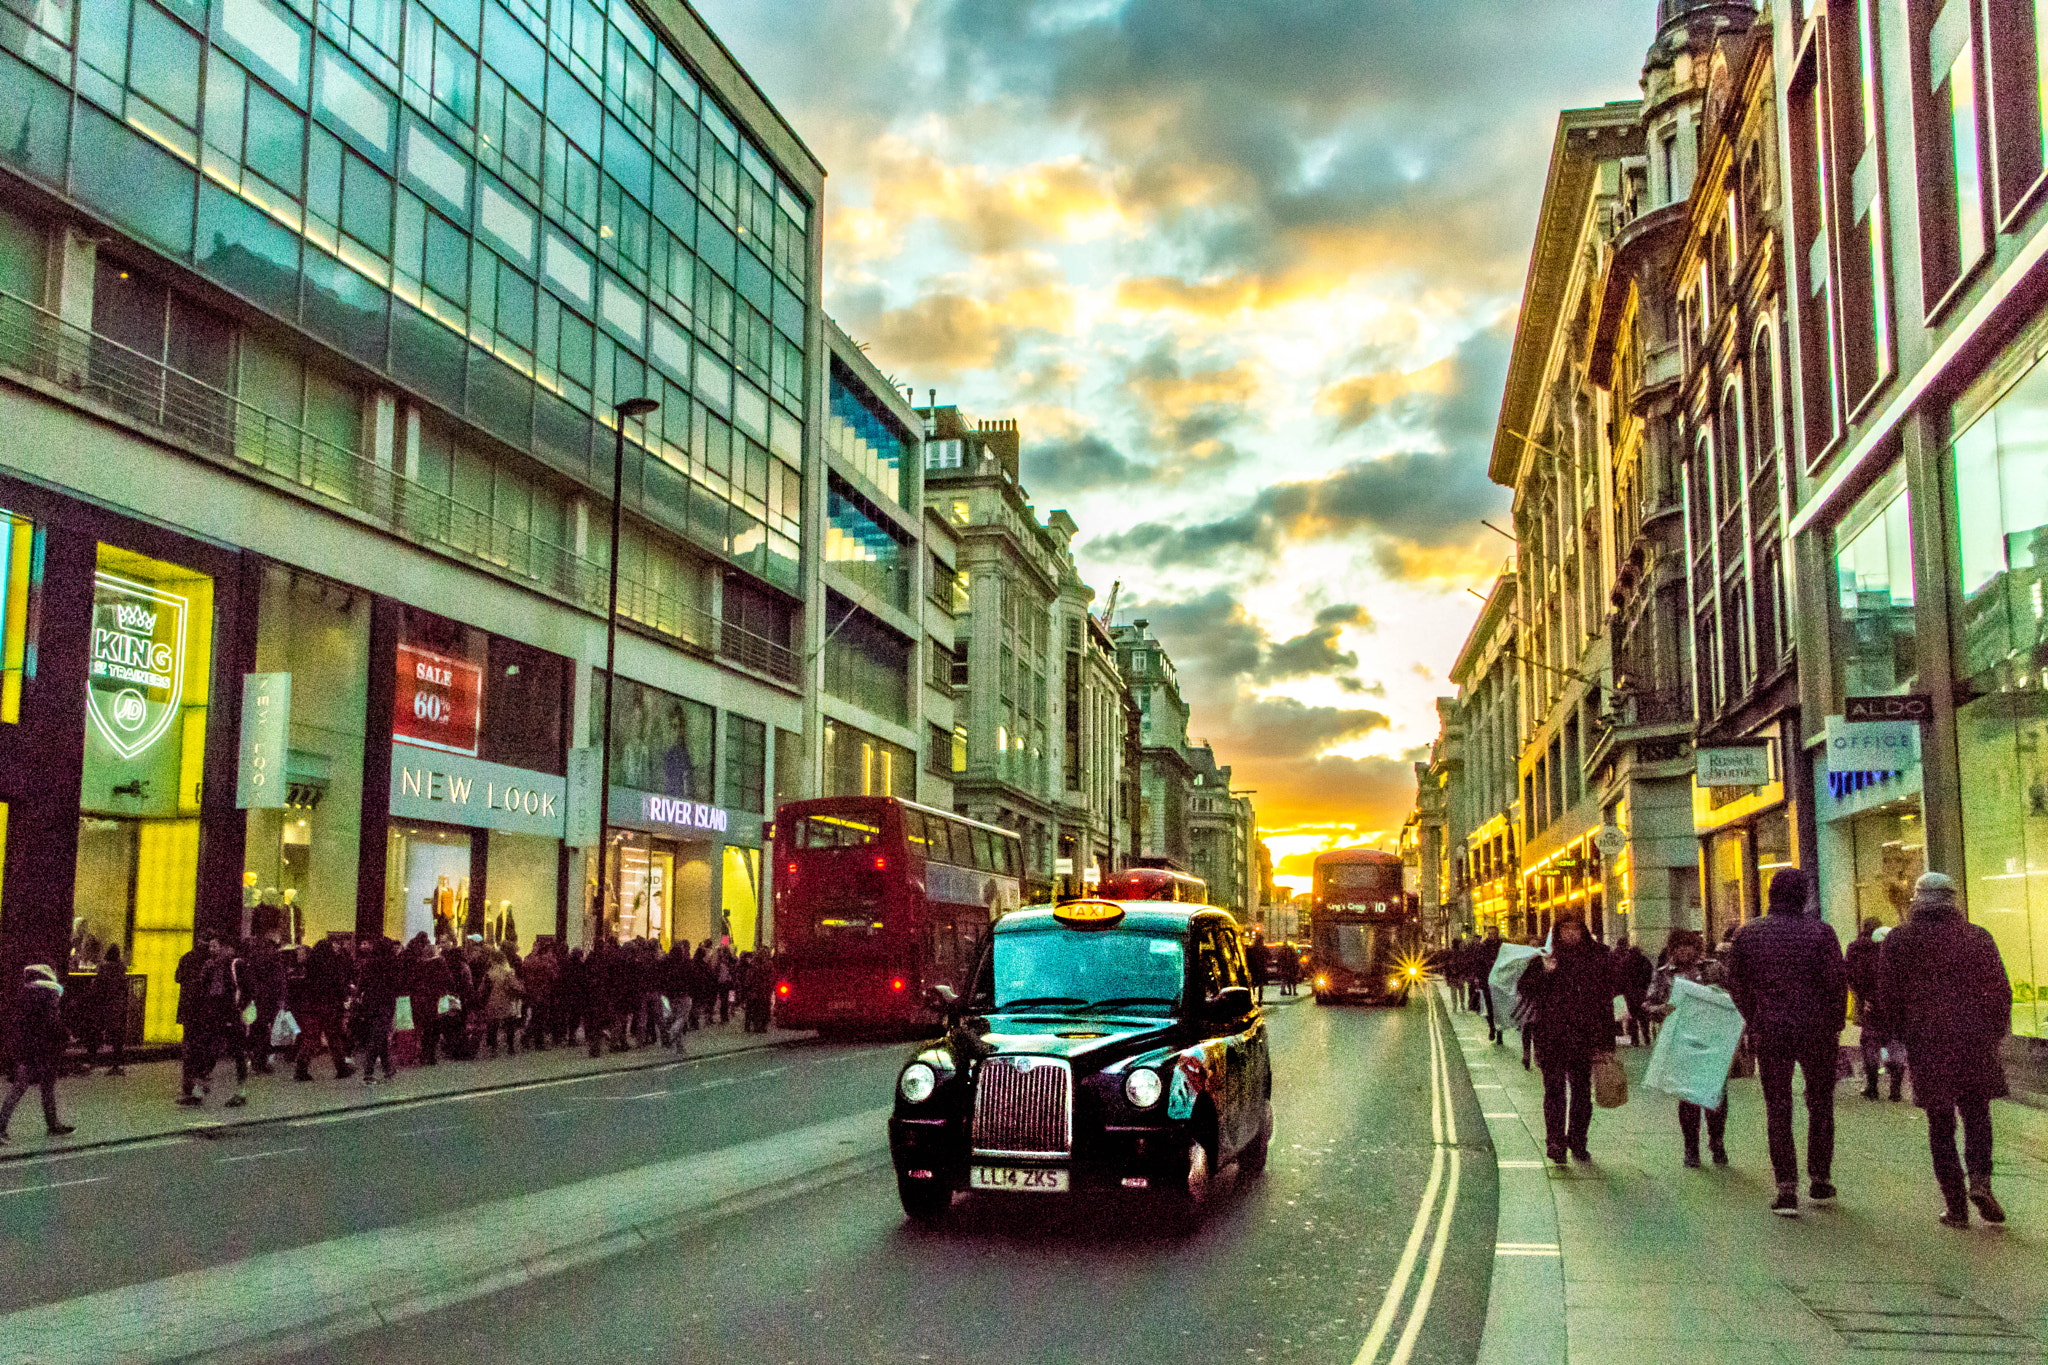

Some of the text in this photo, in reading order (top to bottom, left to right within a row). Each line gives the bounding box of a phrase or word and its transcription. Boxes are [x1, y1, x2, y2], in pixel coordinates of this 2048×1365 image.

[94, 627, 172, 673] KING
[108, 663, 171, 689] TRAINERS
[416, 662, 452, 687] SALE
[117, 698, 143, 721] JD
[1851, 700, 1927, 716] ALDO
[1833, 734, 1910, 749] OFFICE
[402, 766, 558, 819] NEW LOOK
[650, 796, 728, 832] RIVER ISLAND
[1067, 905, 1107, 918] TAXI
[1374, 902, 1387, 913] 10
[980, 1166, 1018, 1187] LL14
